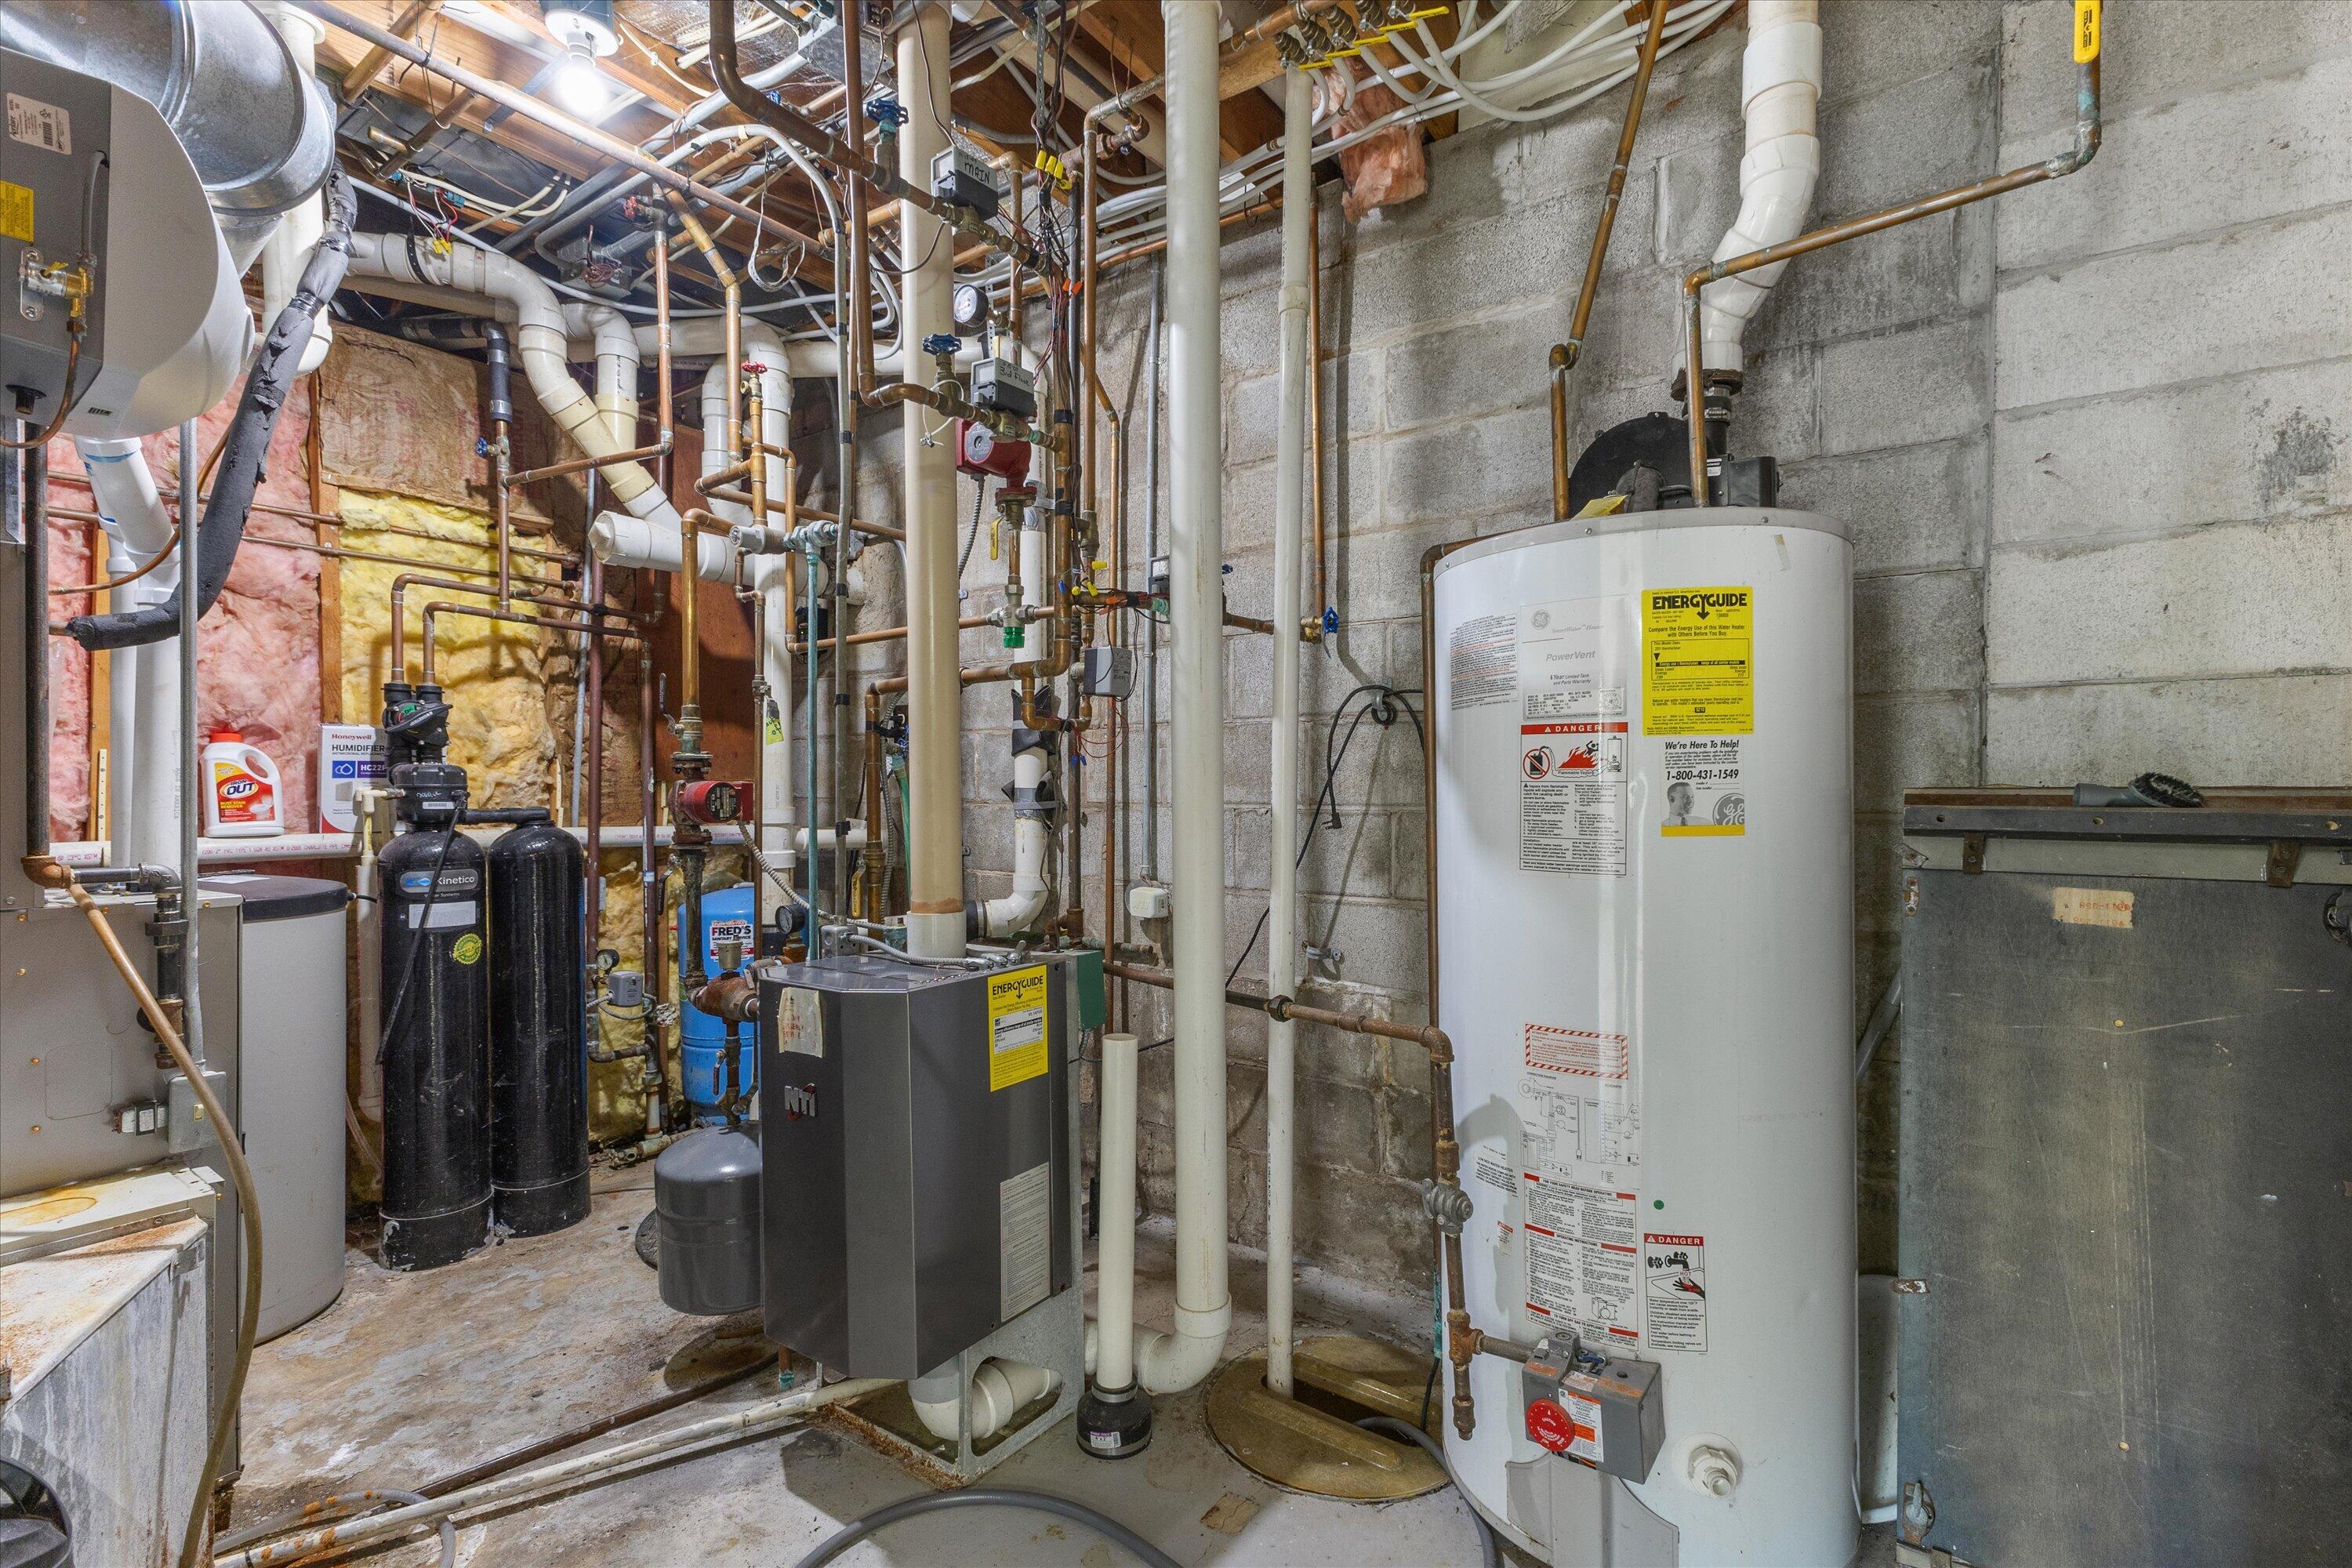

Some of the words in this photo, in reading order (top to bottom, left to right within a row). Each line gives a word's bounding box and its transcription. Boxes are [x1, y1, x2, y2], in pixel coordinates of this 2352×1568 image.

[964, 162, 990, 184] MAIN
[1653, 593, 1748, 610] ENERGYGUIDE
[1546, 651, 1596, 662] PowerVent
[1667, 769, 1739, 780] 1-800-431-1549
[227, 782, 255, 795] OUT
[438, 876, 474, 884] Kinetico
[712, 926, 751, 936] FRED'S
[993, 975, 1044, 996] ENERGYGUIDE
[785, 1085, 816, 1117] NTI
[1658, 1236, 1700, 1245] DANGER
